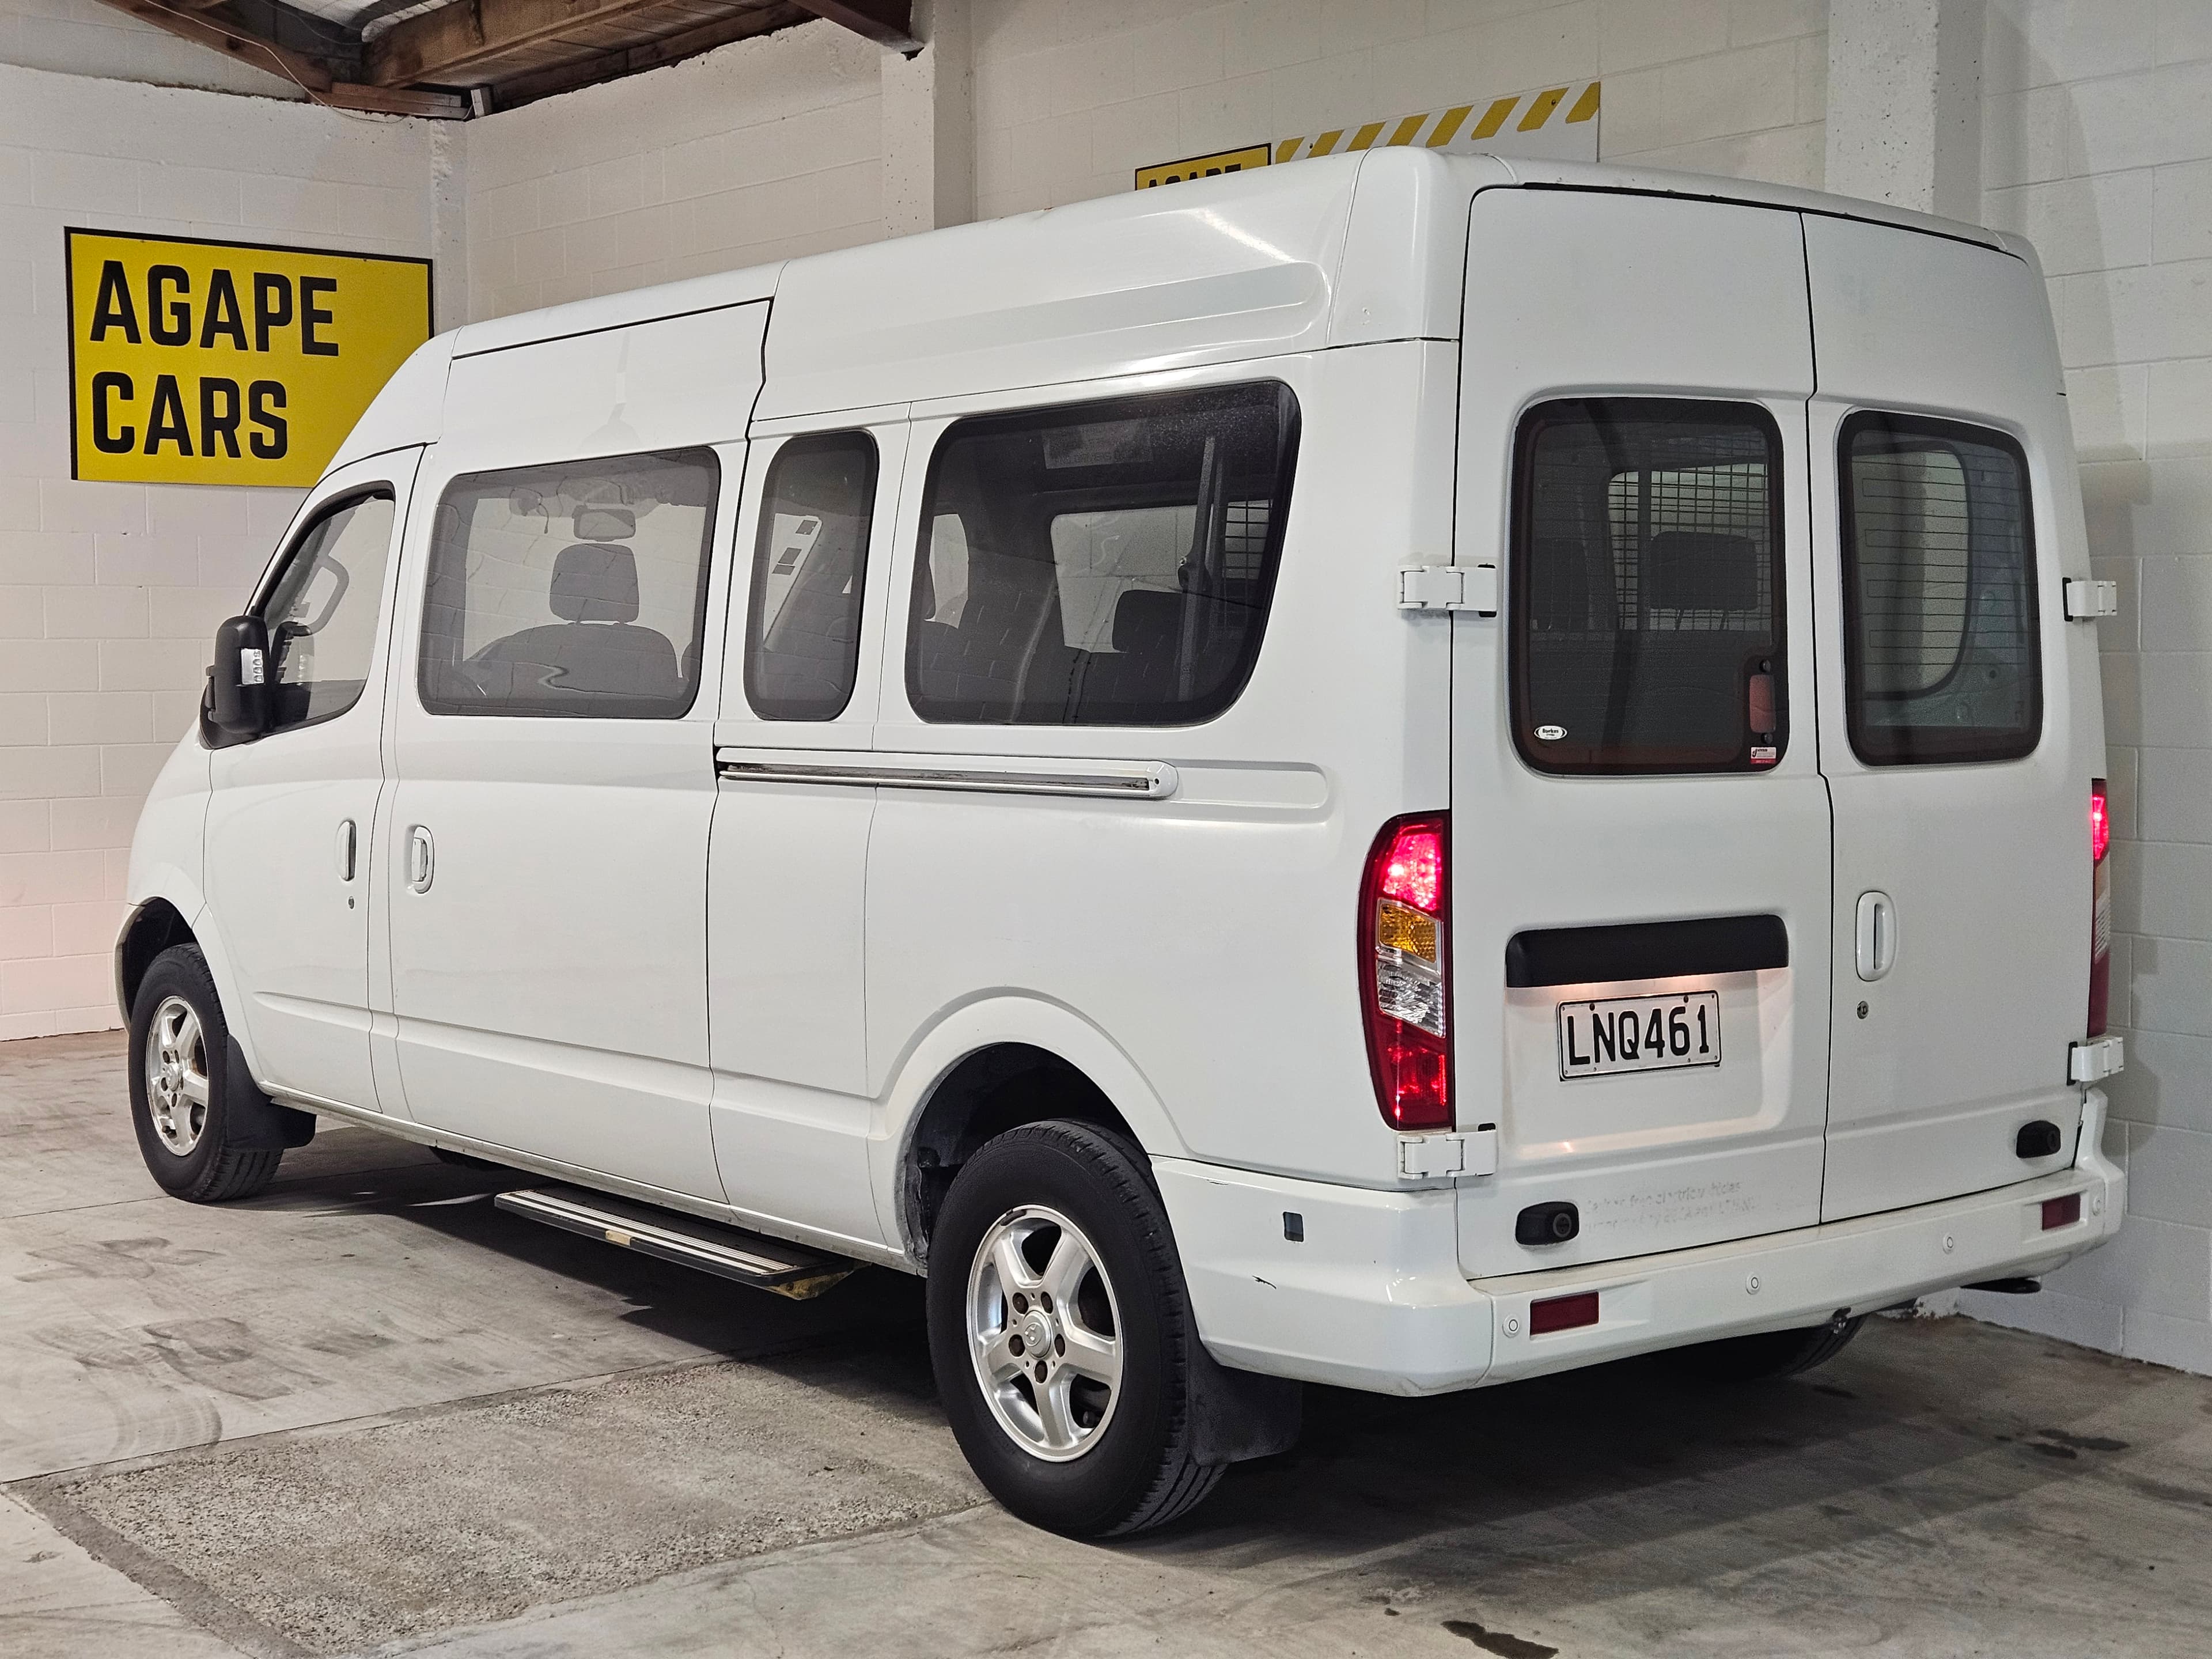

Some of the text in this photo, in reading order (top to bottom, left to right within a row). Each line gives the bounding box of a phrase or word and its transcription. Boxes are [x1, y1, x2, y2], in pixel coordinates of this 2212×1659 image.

[90, 260, 339, 357] AGAPE
[92, 371, 288, 459] CARS
[1567, 1004, 1709, 1066] LNQ461
